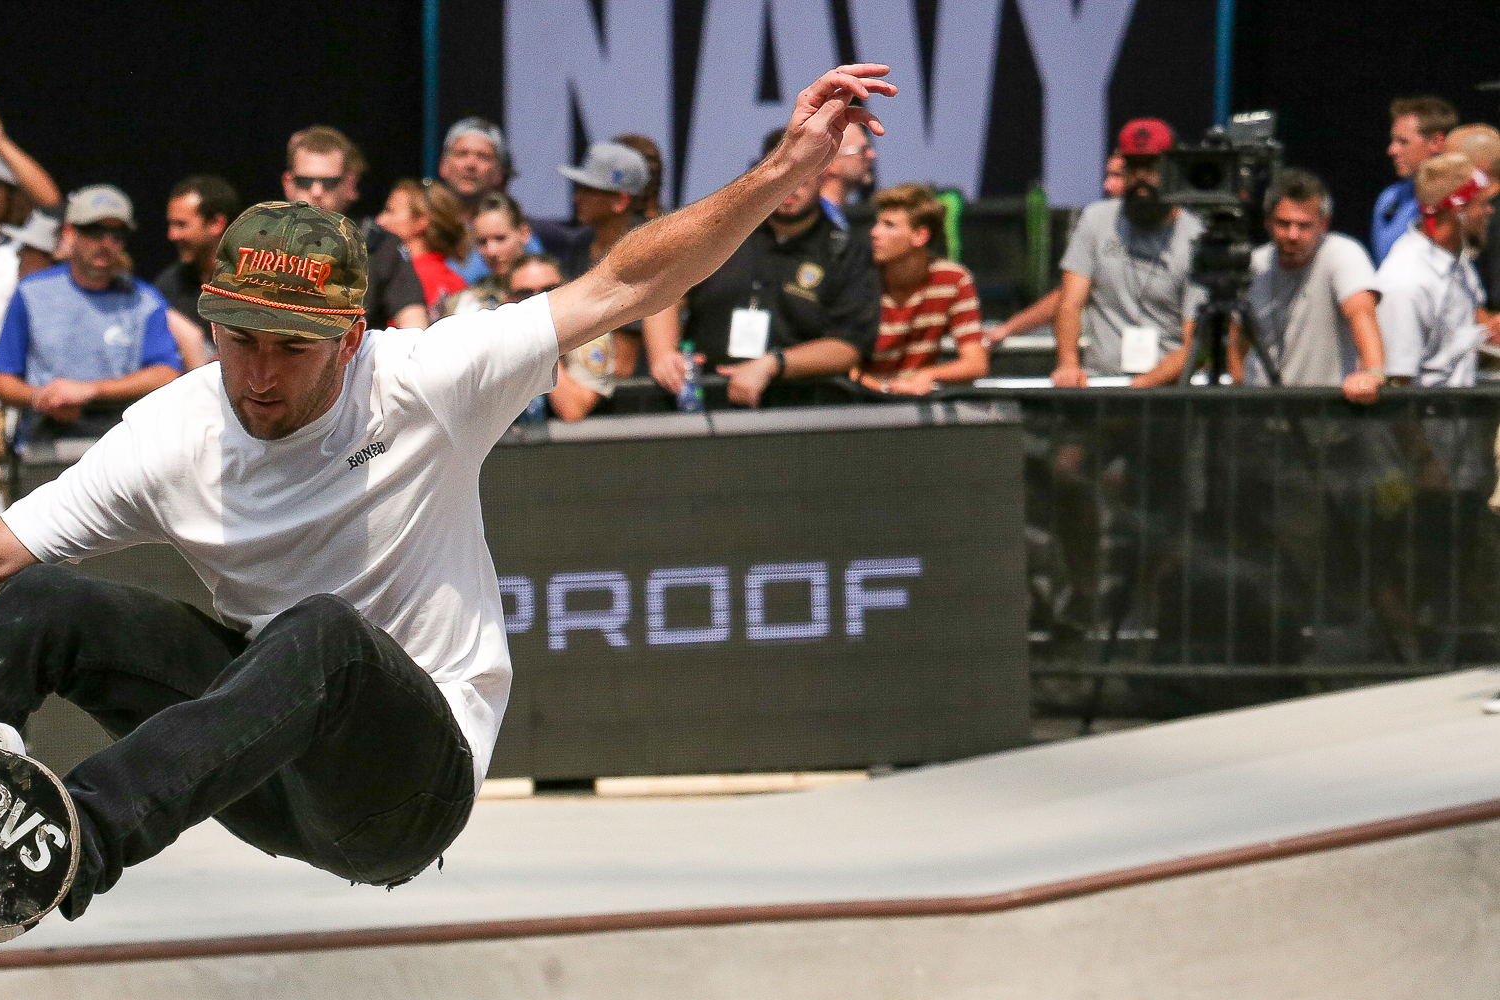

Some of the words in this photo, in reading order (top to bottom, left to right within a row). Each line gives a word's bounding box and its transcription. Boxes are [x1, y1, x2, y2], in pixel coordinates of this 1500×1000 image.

[502, 0, 1137, 222] NAVY
[235, 247, 331, 293] THRASHER
[345, 441, 386, 470] BONES
